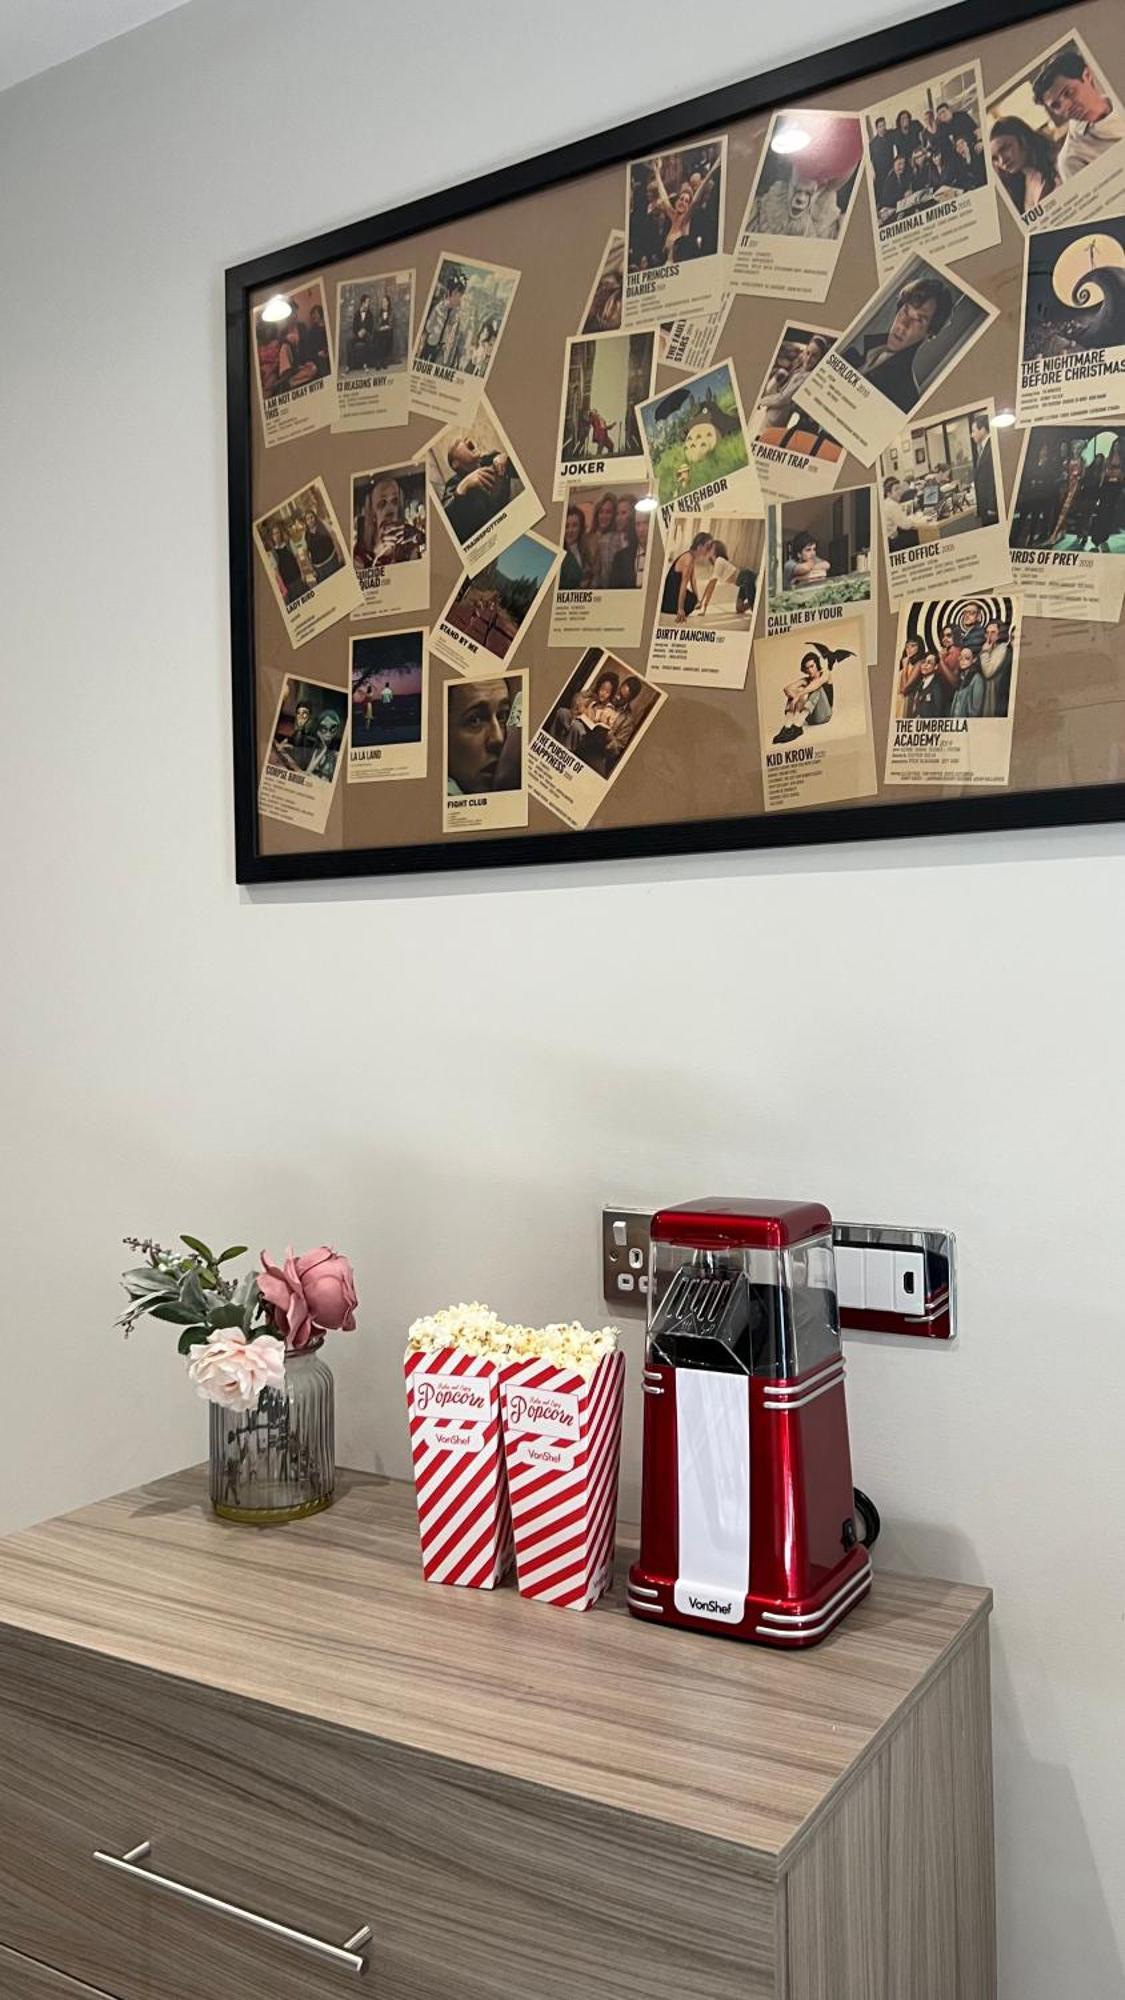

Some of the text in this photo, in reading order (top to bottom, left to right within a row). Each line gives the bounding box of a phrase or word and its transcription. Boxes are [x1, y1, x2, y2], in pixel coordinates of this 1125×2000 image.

[879, 215, 925, 241] CRIMINAL
[926, 200, 958, 222] MINDS
[1021, 204, 1044, 226] YOU
[740, 235, 750, 247] IT
[627, 264, 680, 286] THE PRINCESS
[626, 282, 656, 298] DIARIES
[412, 360, 433, 375] YOUR
[433, 365, 456, 382] NAME
[825, 354, 860, 388] SHERLOCK
[1022, 349, 1105, 375] THE NIGHTMARE
[1022, 359, 1125, 388] BEFORE CHRISTMAS
[756, 445, 787, 465] PARENT
[787, 454, 810, 469] TRAP
[560, 462, 605, 476] JOKER
[678, 479, 728, 509] NEIGHBOR
[889, 553, 907, 567] THE
[908, 542, 941, 562] OFFICE
[1009, 551, 1036, 564] IRDS
[1037, 551, 1052, 565] OF
[1052, 552, 1079, 566] PREY
[360, 577, 380, 591] QUAD
[556, 591, 593, 603] HEATHERS
[768, 606, 843, 628] CALL ME BY YOUR
[440, 623, 479, 654] STAND BY ME
[656, 628, 679, 640] DIRTY
[680, 630, 716, 643] DANCING
[895, 719, 968, 733] THE UMBRELLA
[894, 733, 941, 747] ACADEMY
[537, 732, 584, 774] THE PURSUIT OF
[766, 746, 814, 767] KID KROW
[417, 1382, 485, 1411] Popcorn
[510, 1395, 574, 1426] Popcorn
[435, 1433, 471, 1445] VonShef
[528, 1449, 561, 1463] VonShef
[688, 1596, 732, 1615] VonShef
